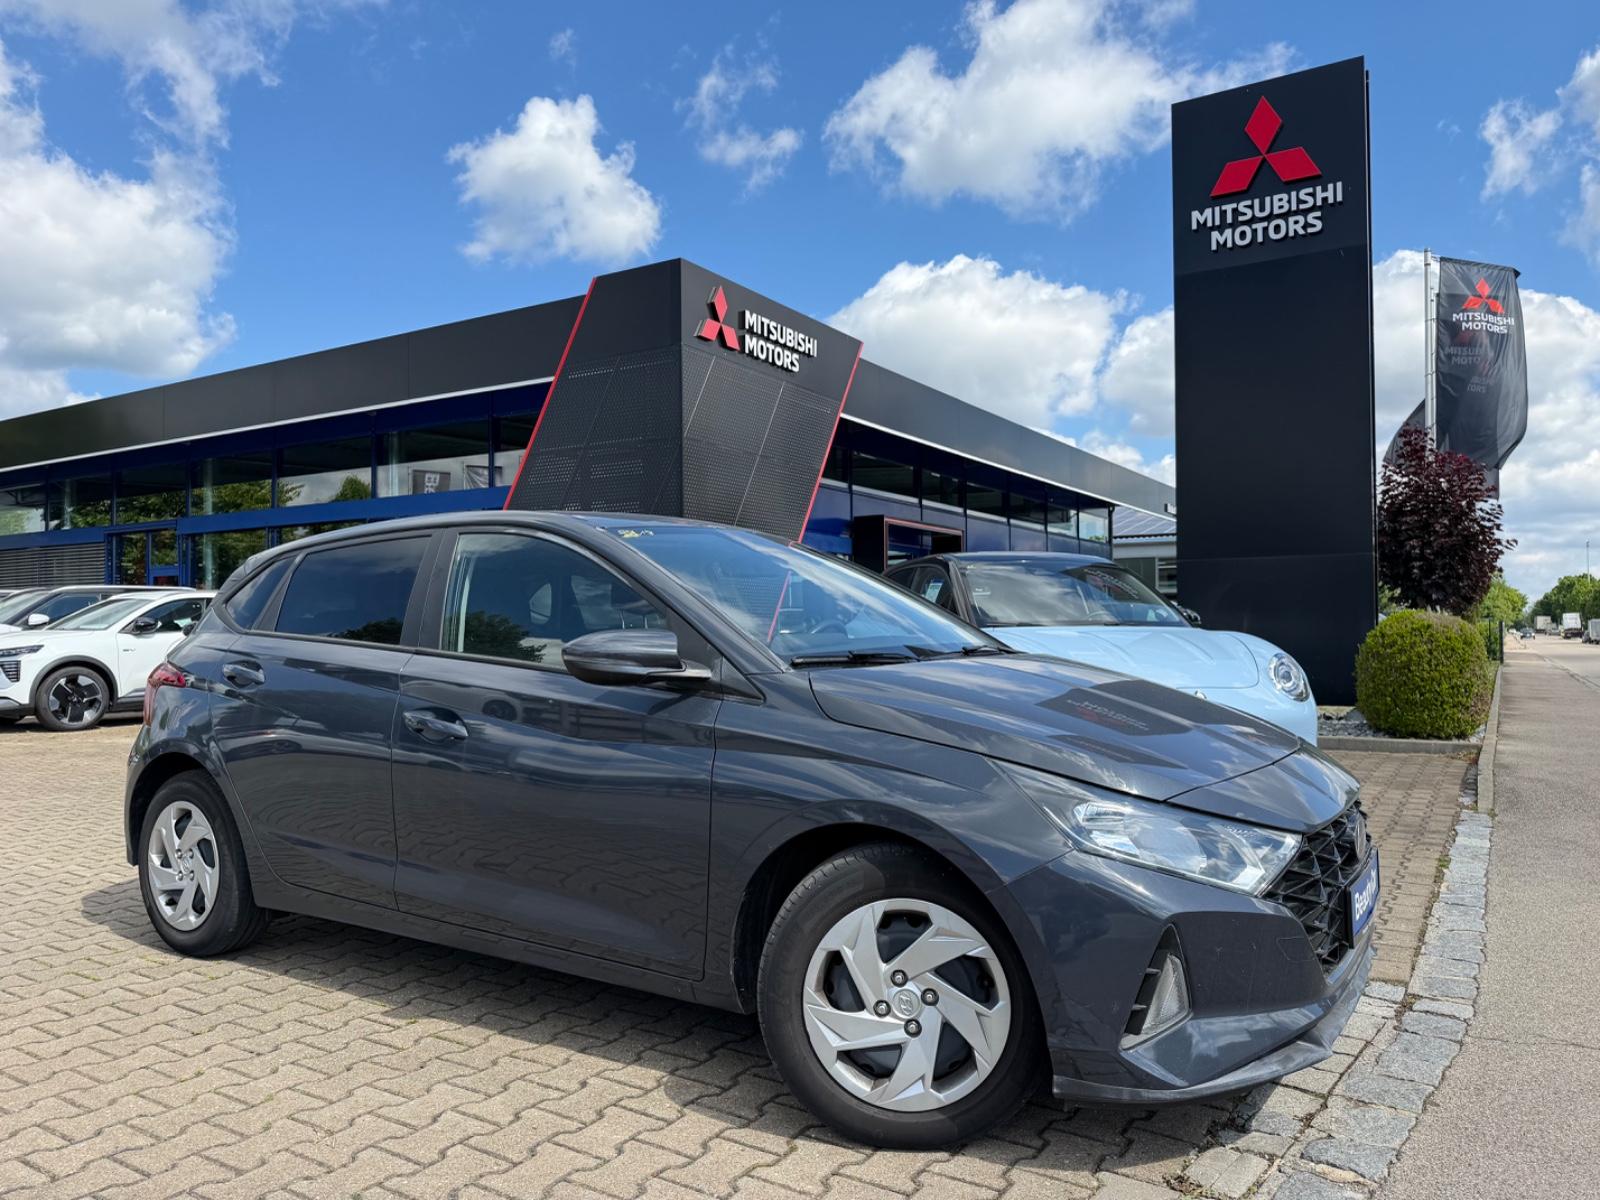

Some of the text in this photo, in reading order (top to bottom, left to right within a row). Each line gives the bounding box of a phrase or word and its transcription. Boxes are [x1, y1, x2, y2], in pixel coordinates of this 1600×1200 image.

[1191, 181, 1343, 230] MITSUBISHI
[1211, 211, 1323, 251] MOTORS
[744, 309, 818, 358] MITSUBISHI
[1452, 311, 1515, 326] MITSUBISHI
[1461, 321, 1508, 334] MOTORS
[744, 334, 800, 373] MOTORS
